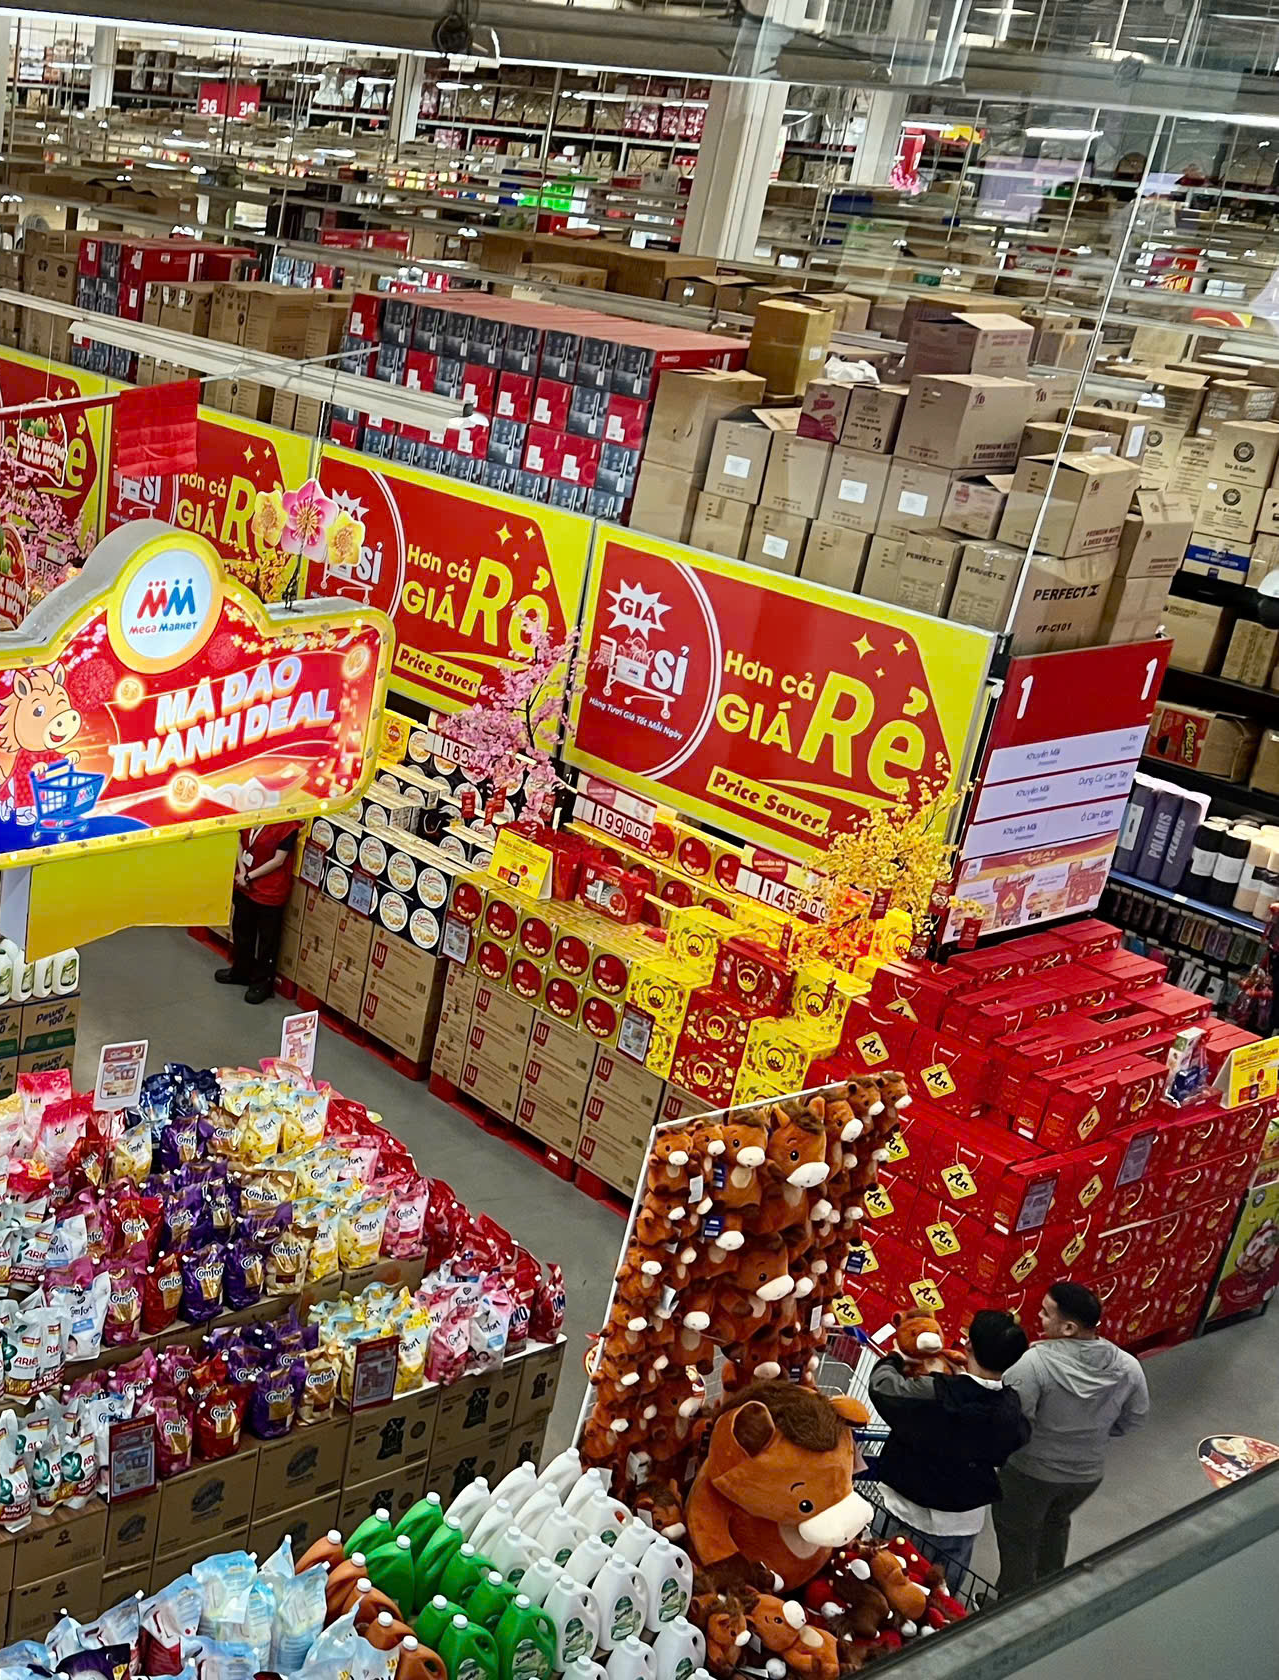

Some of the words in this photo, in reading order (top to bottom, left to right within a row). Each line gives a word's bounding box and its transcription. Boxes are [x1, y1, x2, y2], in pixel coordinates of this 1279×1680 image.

[201, 98, 218, 114] 36
[177, 499, 217, 539] GIÁ
[408, 543, 443, 575] Hơn
[447, 558, 472, 584] cả
[906, 551, 937, 566] PERFECT
[1033, 587, 1088, 601] PERFECT
[402, 580, 455, 629] GIÁ
[458, 556, 552, 660] Rẻ
[618, 597, 657, 625] GIÁ
[399, 647, 432, 675] Price
[435, 659, 481, 692] Saver
[651, 645, 690, 696] SỈ
[723, 649, 774, 687] Hơn
[781, 672, 816, 701] cả
[1140, 657, 1158, 701] 1
[1016, 674, 1034, 720] 1
[243, 688, 335, 745] DEAL
[588, 697, 607, 713] Hàng
[607, 703, 623, 717] Tươi
[623, 709, 635, 722] Giá
[636, 714, 648, 727] Tốt
[648, 718, 663, 732] Mỗi
[663, 725, 684, 741] Ngày
[716, 693, 792, 754] GIÁ
[797, 670, 929, 797] Rẻ
[712, 771, 760, 804] Price
[764, 793, 824, 830] Saver
[1147, 811, 1173, 859] POLARIS
[35, 1004, 67, 1025] Power
[48, 1013, 64, 1027] 100
[862, 1038, 883, 1057] An
[927, 1069, 949, 1090] An
[947, 1172, 970, 1191] An
[866, 1191, 888, 1210] An
[272, 1243, 303, 1257] Comfort
[931, 1228, 954, 1249] An
[915, 1286, 937, 1305] An
[835, 1300, 856, 1318] An
[307, 1368, 337, 1387] Comfort
